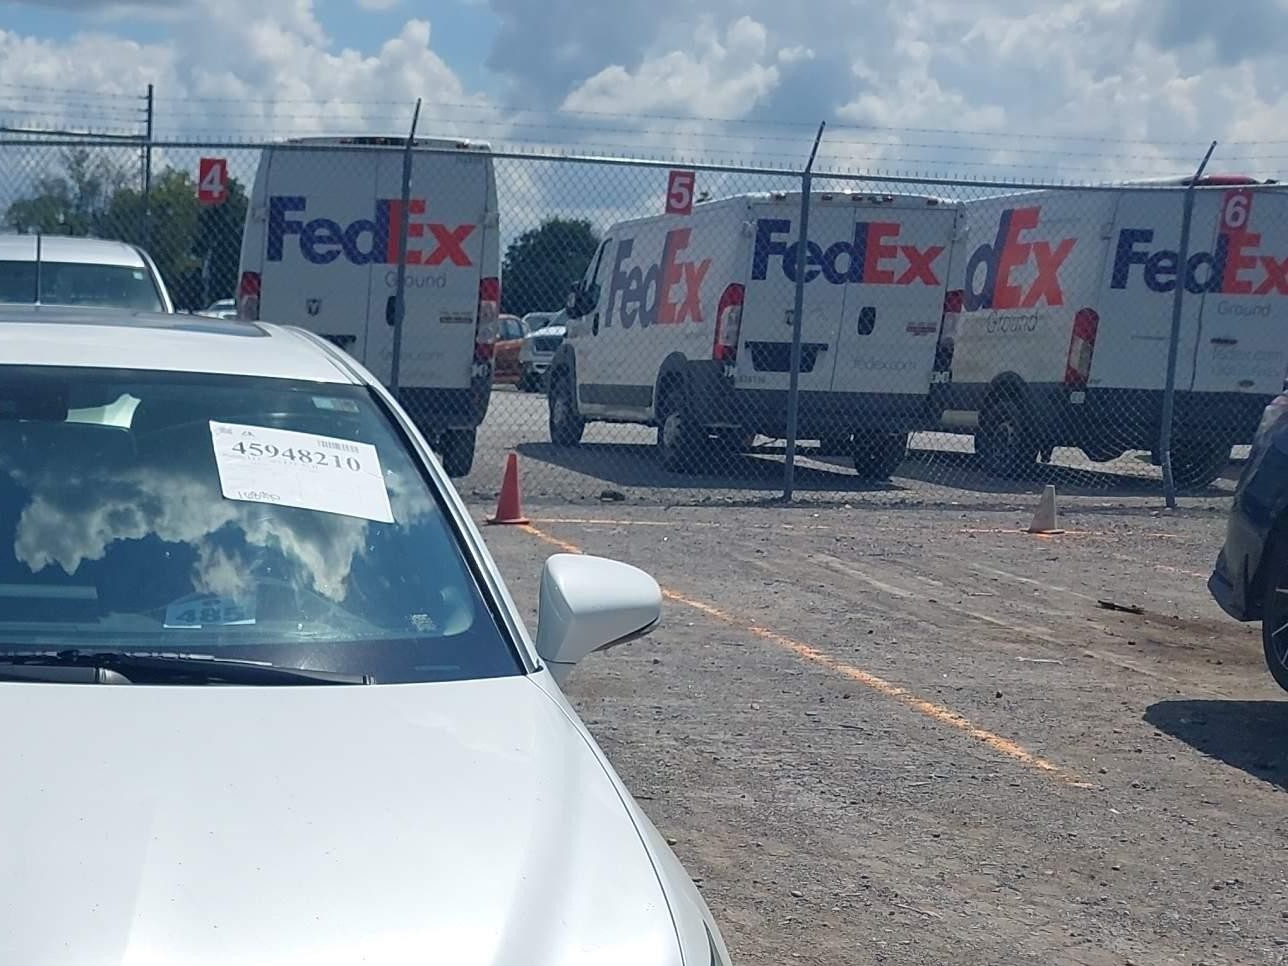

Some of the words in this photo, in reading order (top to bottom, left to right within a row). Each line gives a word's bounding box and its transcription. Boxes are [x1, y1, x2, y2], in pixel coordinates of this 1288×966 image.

[201, 164, 224, 197] 4
[669, 176, 691, 209] 5
[1224, 196, 1248, 229] 6
[267, 197, 476, 266] FedEx
[751, 218, 946, 286] FedEx
[964, 207, 1078, 312] dEx
[1110, 229, 1288, 295] FedEx
[385, 271, 447, 289] Gound
[605, 228, 711, 328] FedEx
[986, 311, 1039, 333] Ground
[232, 440, 362, 472] 45948210
